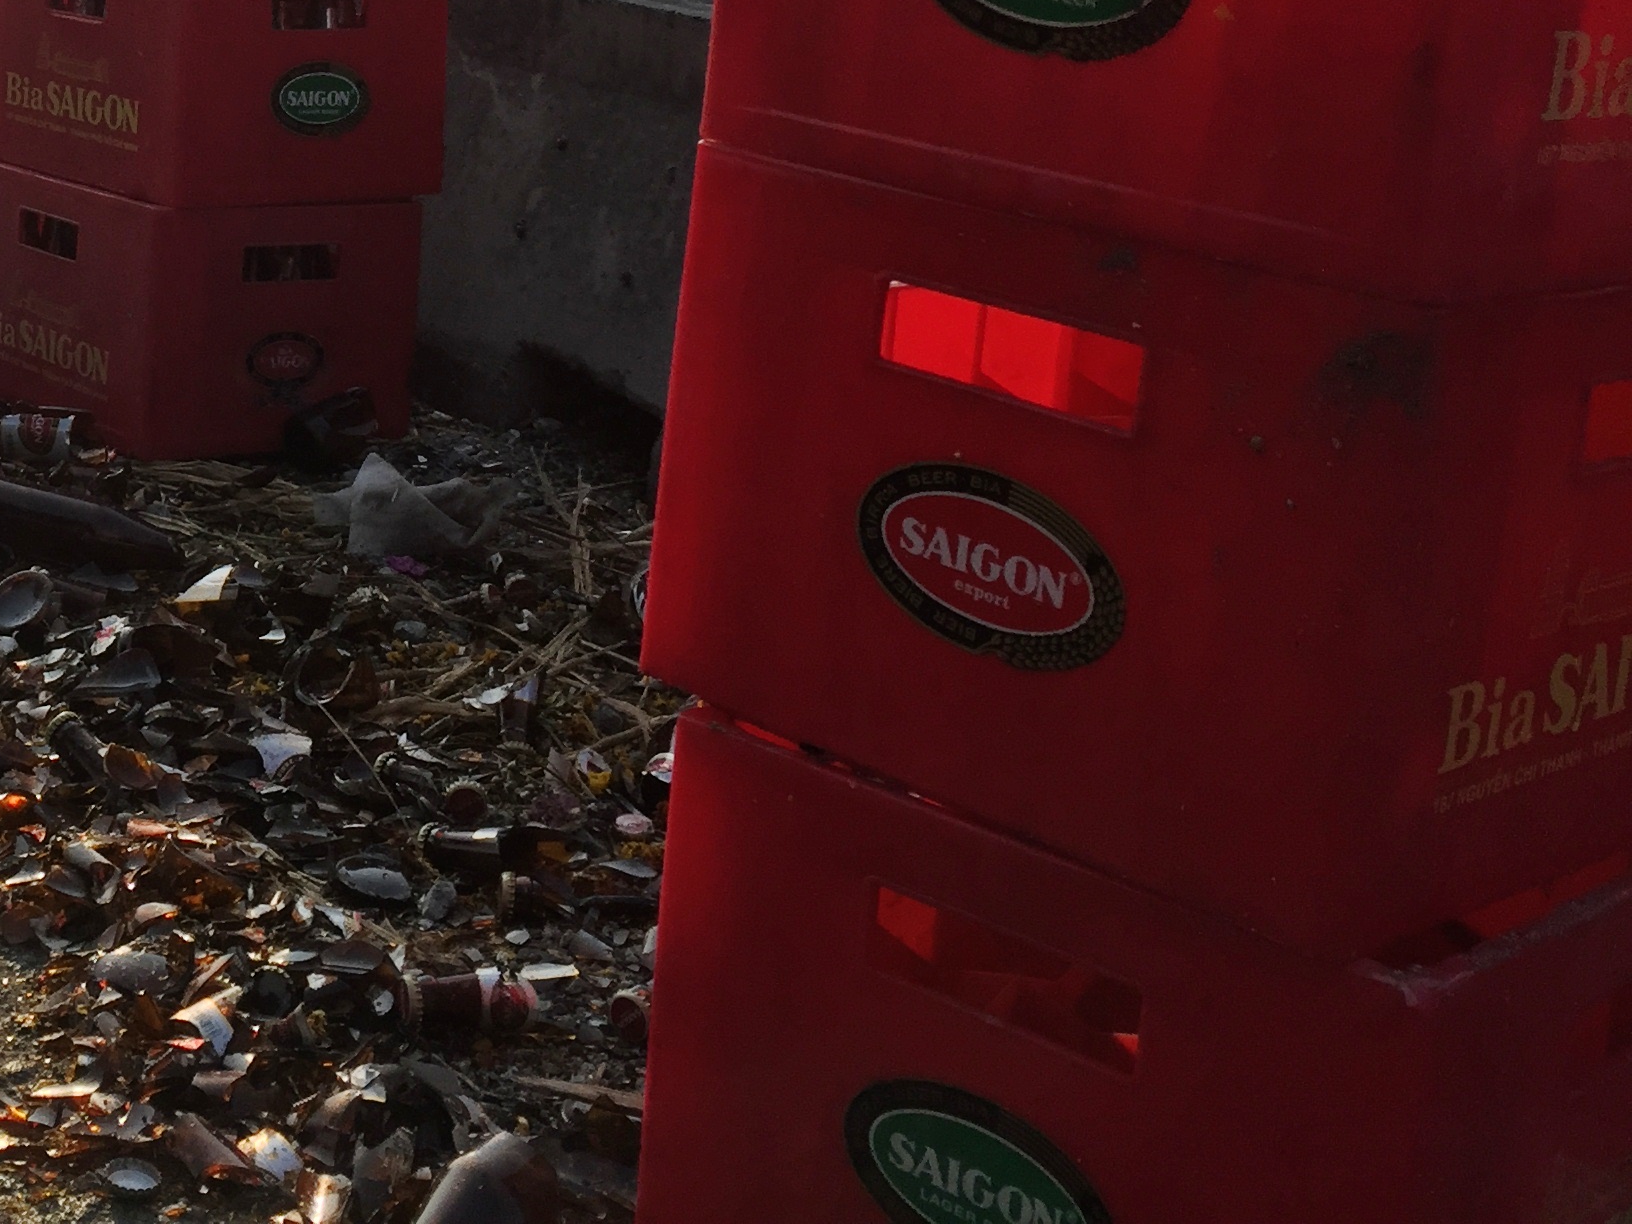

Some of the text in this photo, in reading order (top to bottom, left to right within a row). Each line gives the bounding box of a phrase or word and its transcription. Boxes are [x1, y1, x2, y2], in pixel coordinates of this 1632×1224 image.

[4, 71, 44, 111] Bia
[46, 80, 140, 135] SAIGON
[286, 89, 350, 107] SAIGON
[1540, 30, 1632, 121] Bia
[18, 318, 110, 385] SAIGON
[908, 470, 1002, 495] BEER BIA
[899, 516, 1068, 610] SAIGON
[954, 577, 1011, 611] export
[932, 610, 977, 642] BIER
[1437, 676, 1536, 774] Bia
[887, 1131, 1063, 1224] SAIGON
